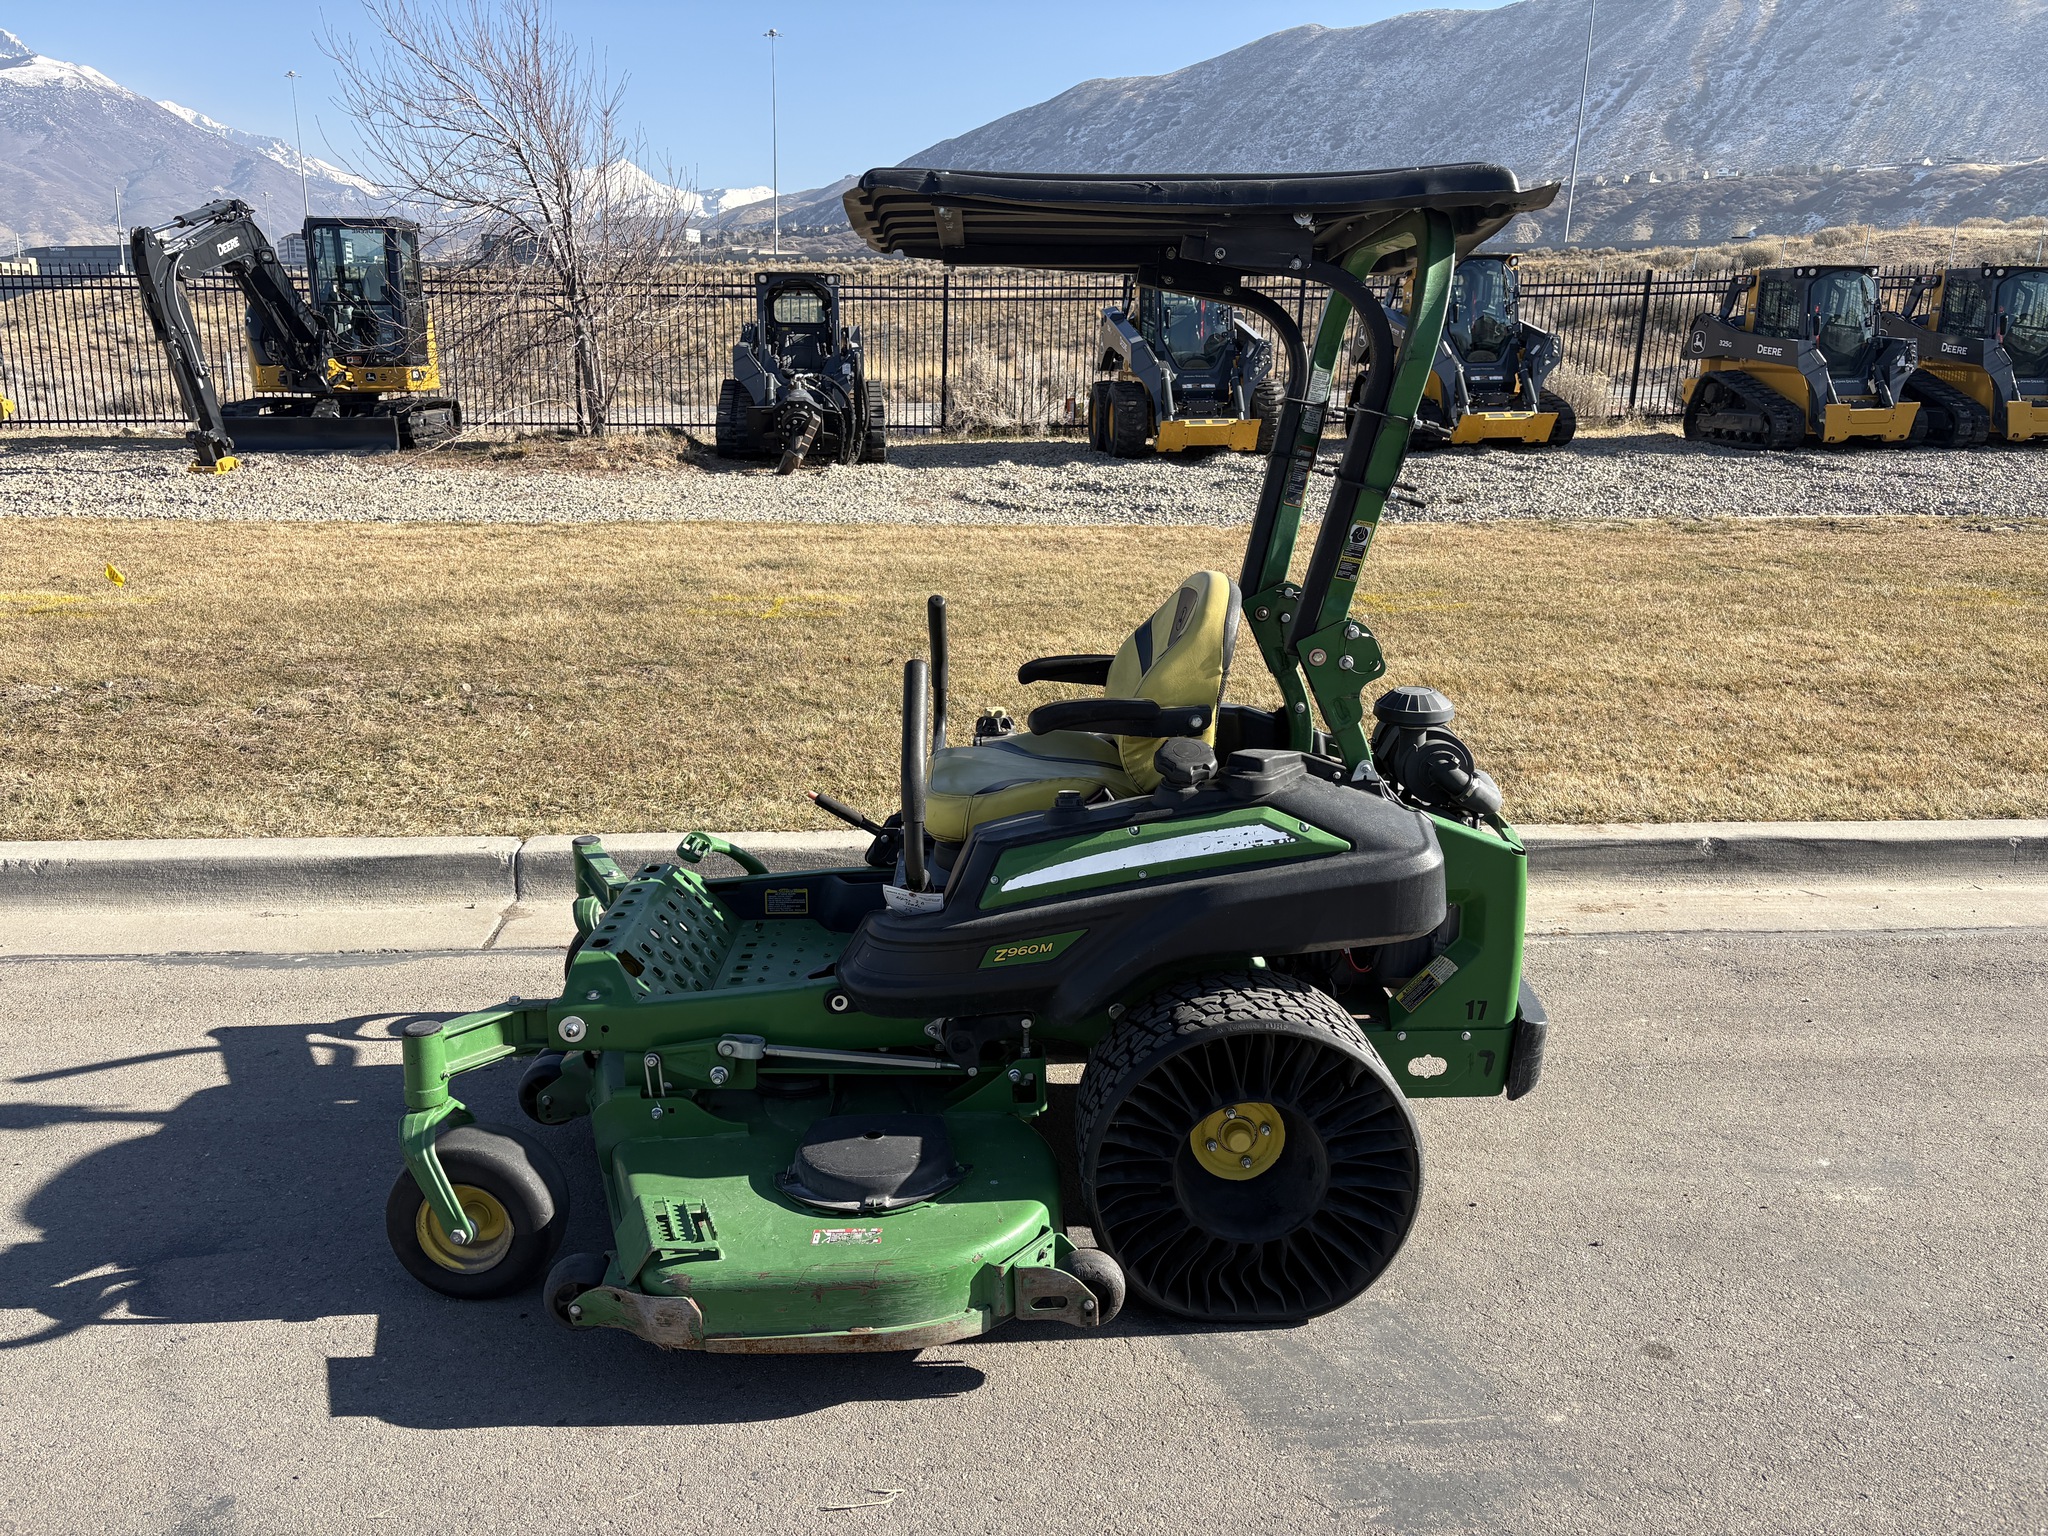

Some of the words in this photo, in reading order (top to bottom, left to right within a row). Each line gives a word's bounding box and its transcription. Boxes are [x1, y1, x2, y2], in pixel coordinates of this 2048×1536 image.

[216, 235, 240, 256] DEERE
[1756, 343, 1783, 357] DEERE
[1941, 342, 1968, 355] DEERE
[993, 942, 1054, 962] Z960M
[1465, 1000, 1488, 1020] 17
